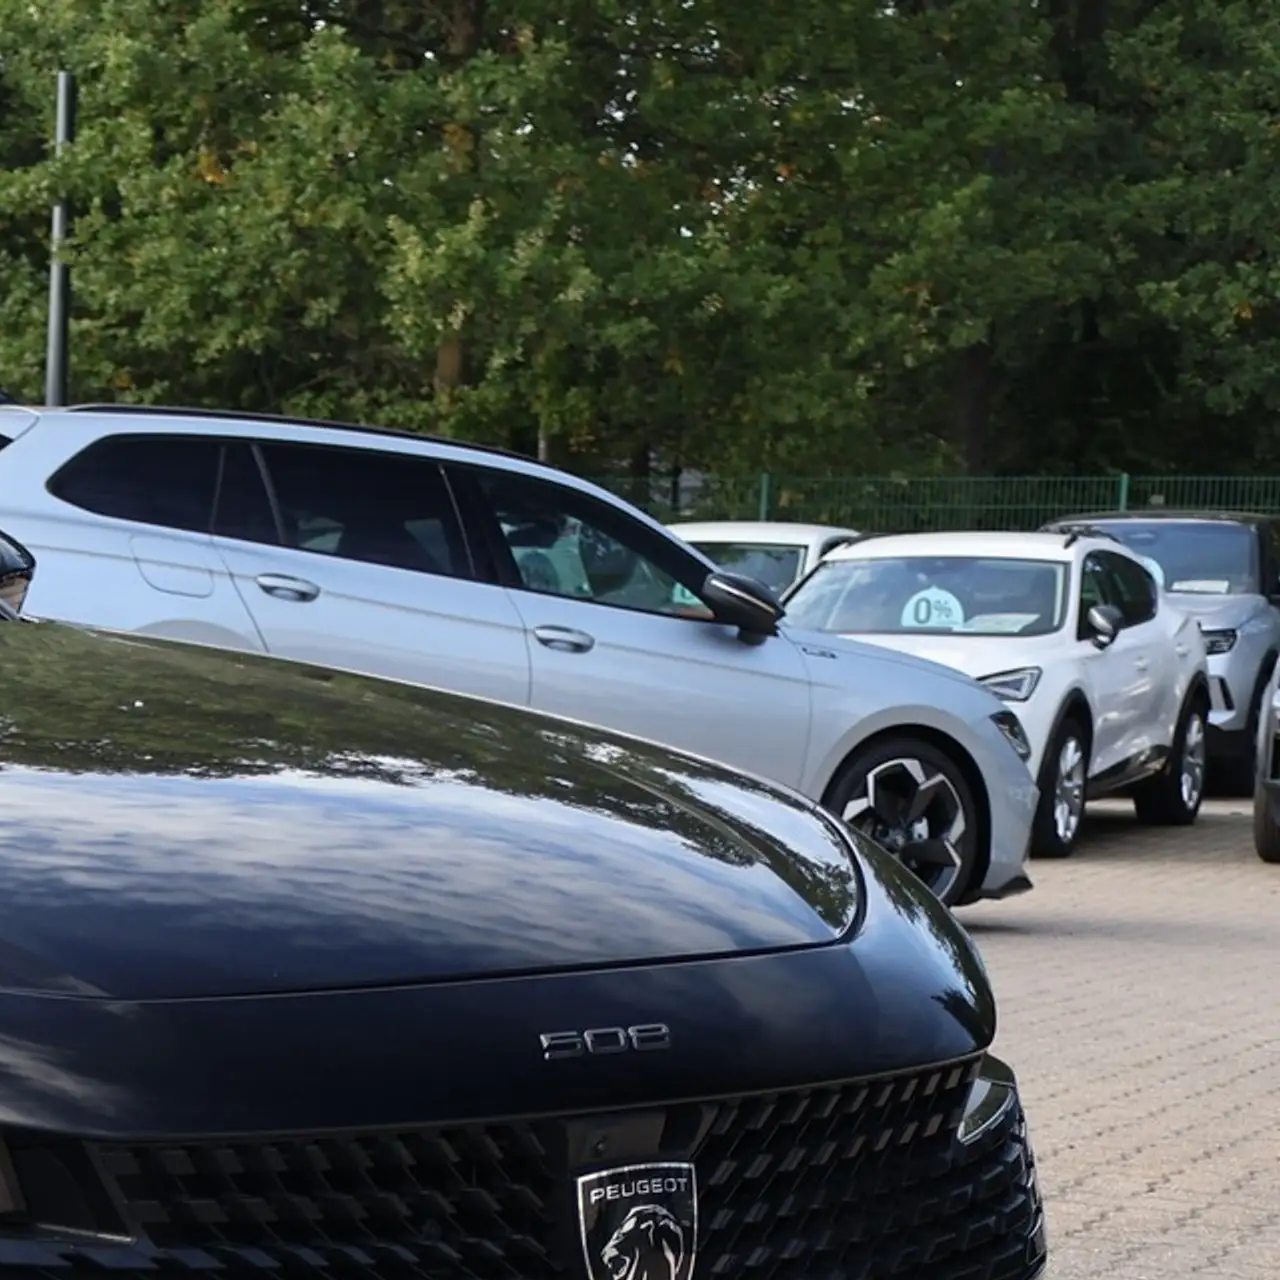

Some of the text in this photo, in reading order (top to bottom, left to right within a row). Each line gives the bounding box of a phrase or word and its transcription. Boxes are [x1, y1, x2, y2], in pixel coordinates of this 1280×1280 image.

[915, 597, 954, 624] 0%
[539, 1022, 671, 1060] 508
[590, 1177, 688, 1204] PEUGEOT
